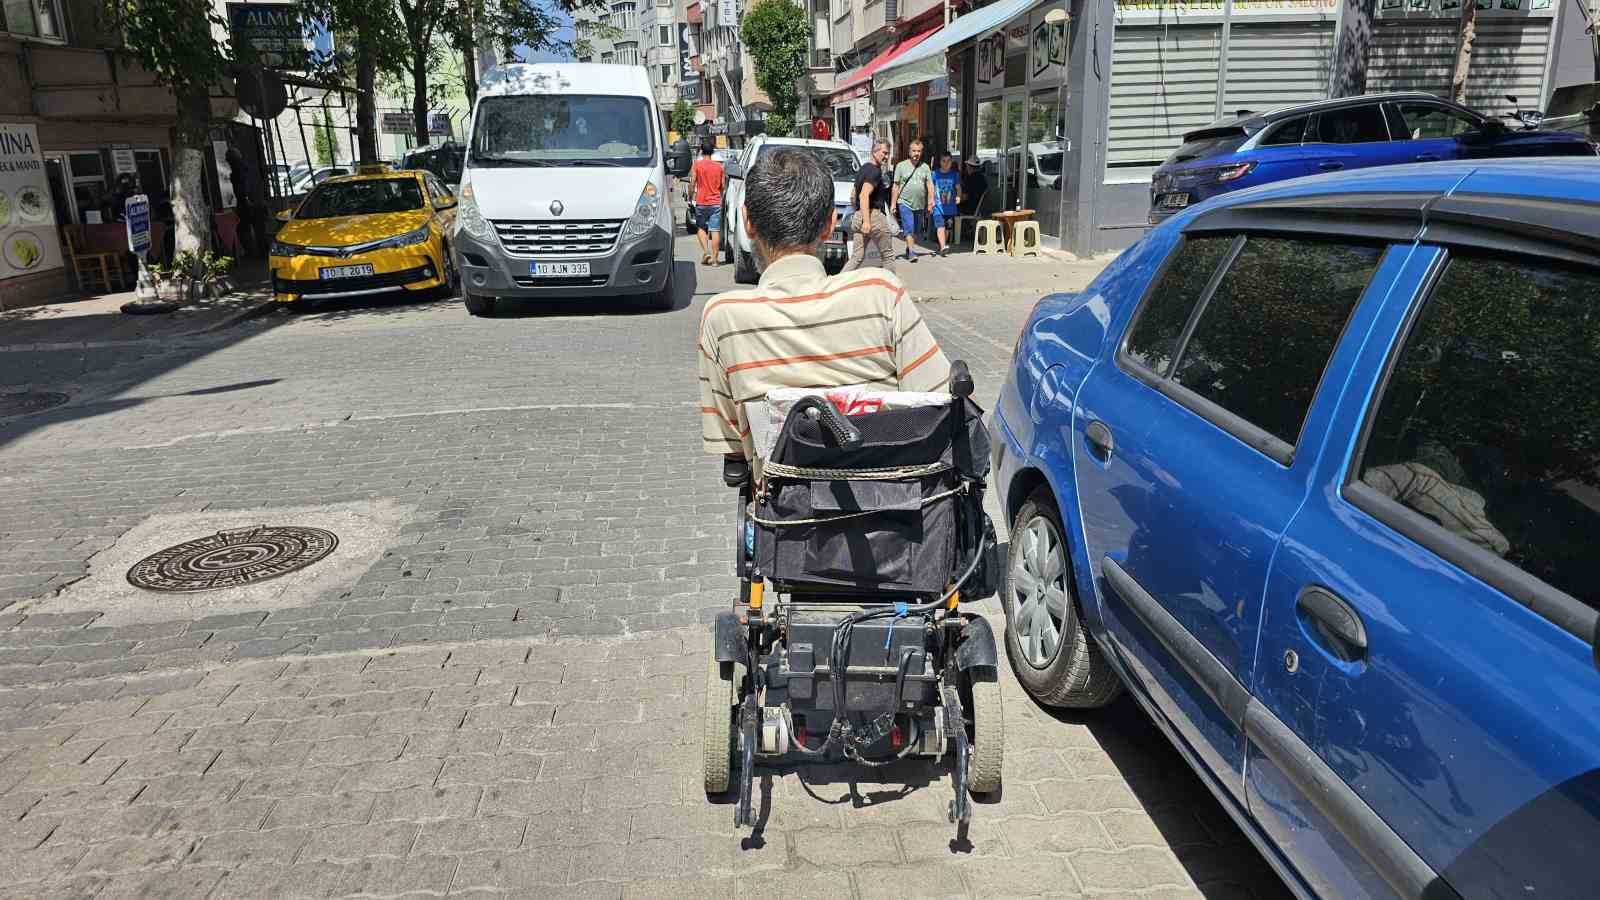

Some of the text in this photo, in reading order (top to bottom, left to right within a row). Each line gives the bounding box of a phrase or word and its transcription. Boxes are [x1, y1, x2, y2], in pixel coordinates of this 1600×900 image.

[325, 269, 336, 278] 10
[349, 265, 372, 276] 2019
[537, 263, 588, 274] 10 AJN 335
